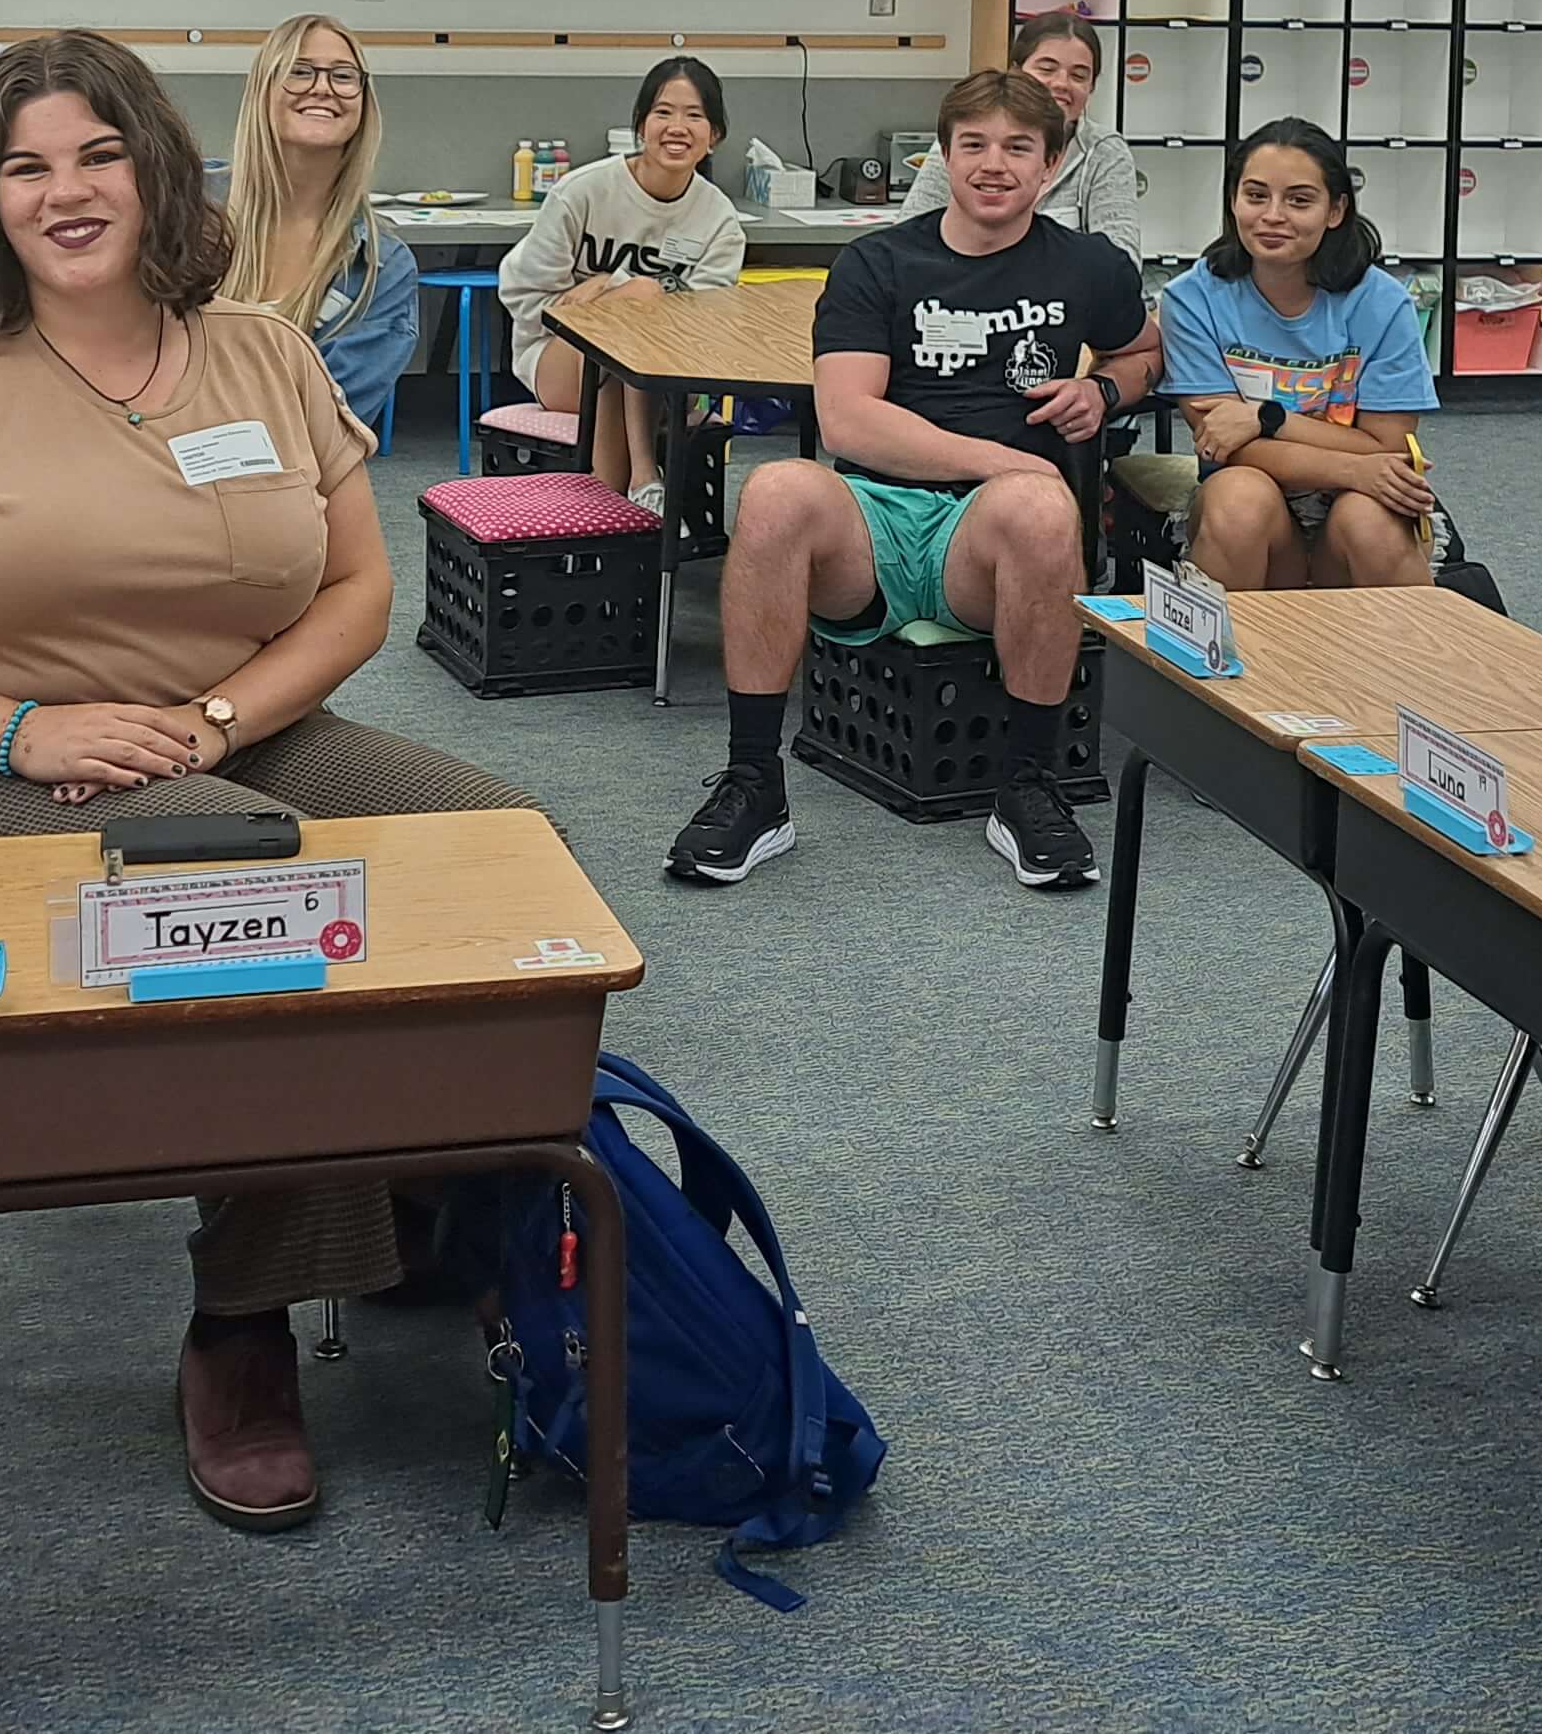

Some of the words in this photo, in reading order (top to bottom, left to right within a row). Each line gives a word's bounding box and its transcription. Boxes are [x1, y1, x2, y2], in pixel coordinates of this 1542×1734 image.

[1429, 750, 1467, 803] Luna
[306, 891, 320, 911] 6
[146, 912, 287, 951] Tayzen
